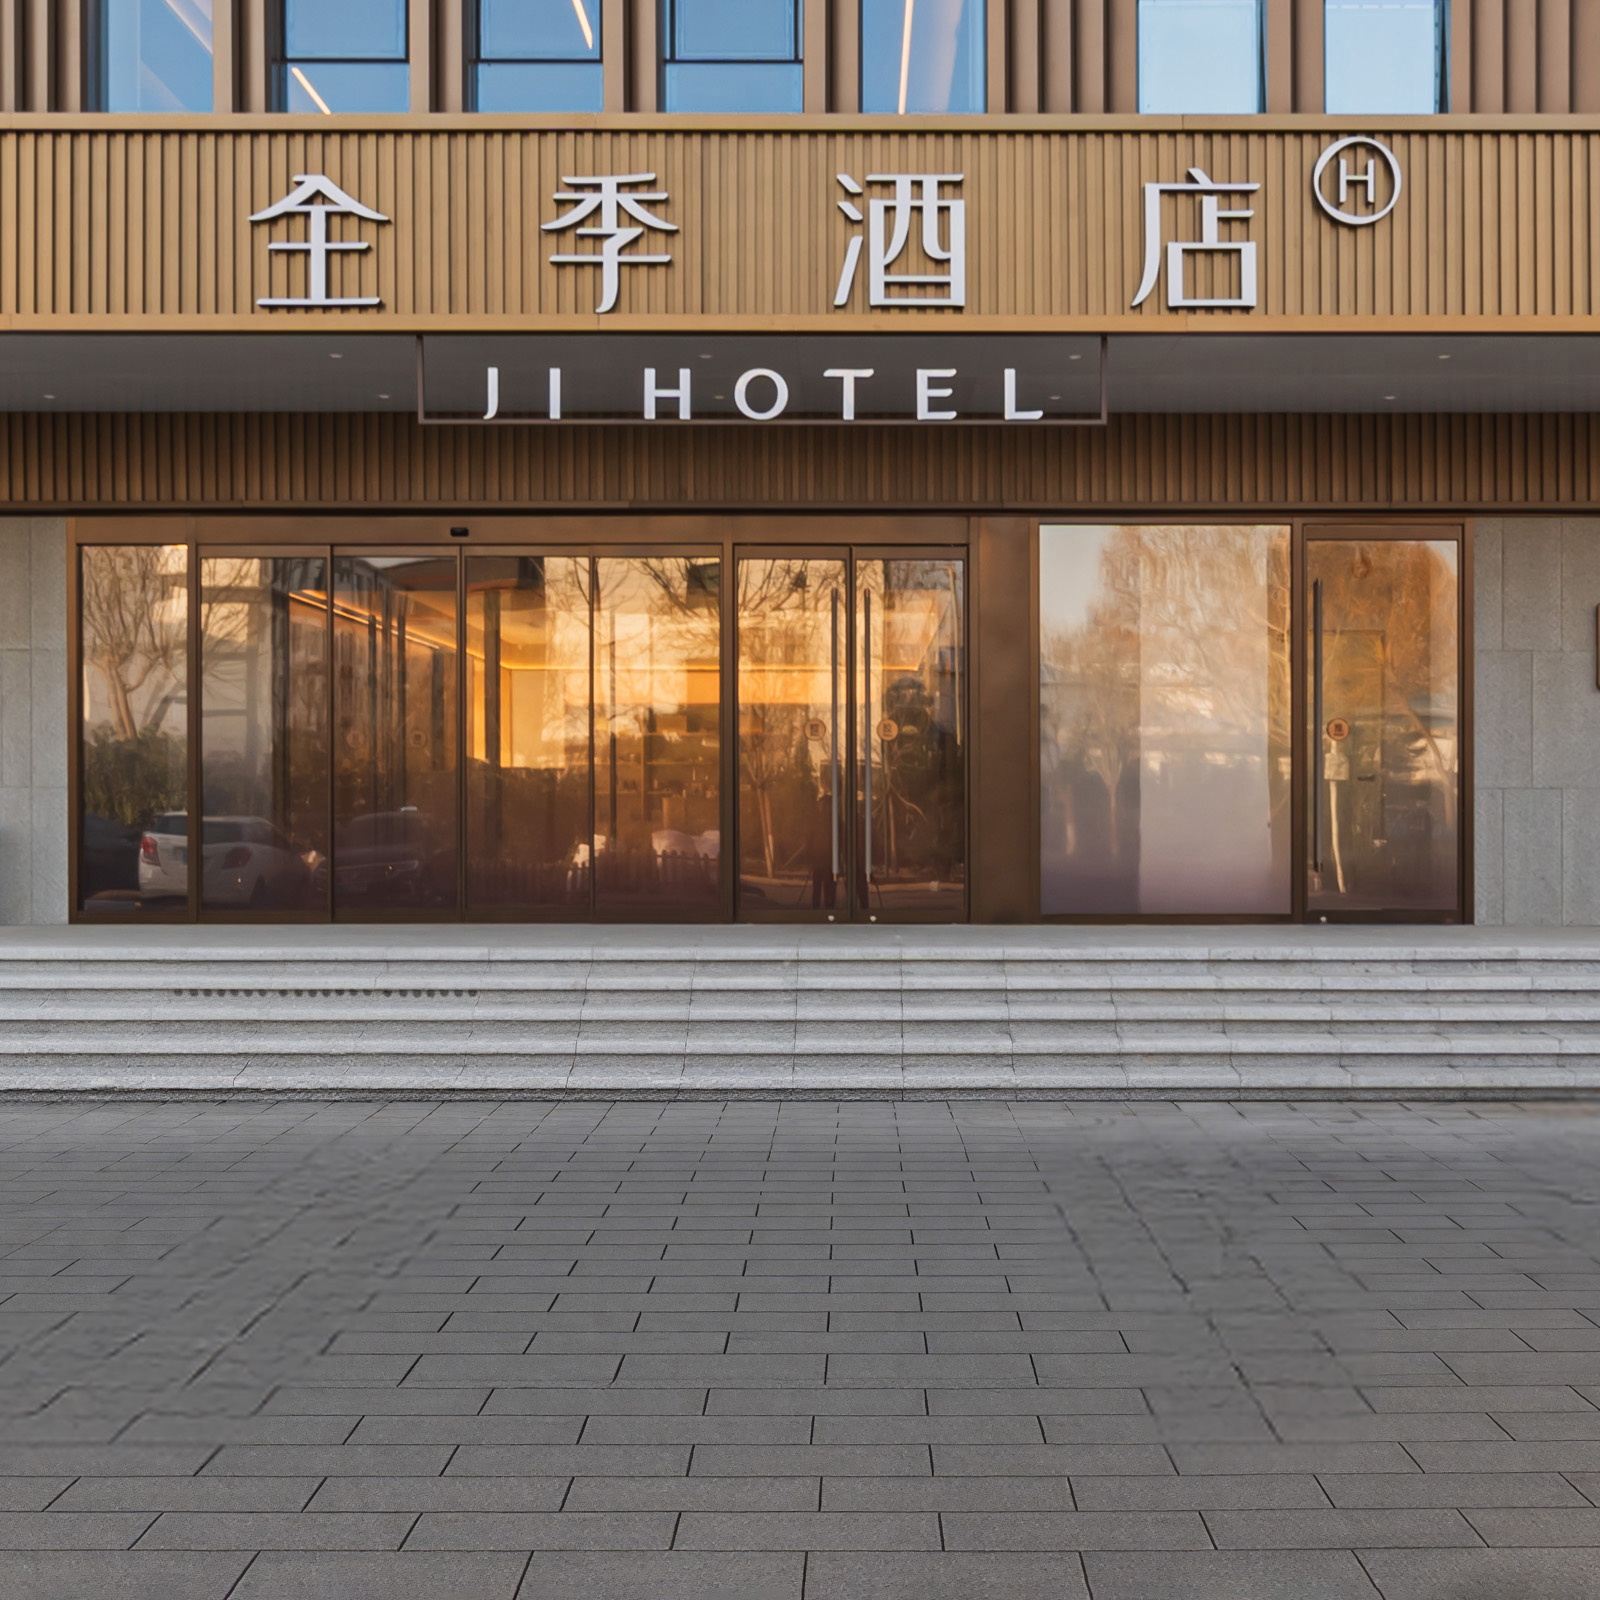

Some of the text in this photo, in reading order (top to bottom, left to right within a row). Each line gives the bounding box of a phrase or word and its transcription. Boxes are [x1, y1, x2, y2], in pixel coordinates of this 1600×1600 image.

[247, 166, 1261, 314] 全季酒店
[483, 367, 1045, 421] JI HOTEL
